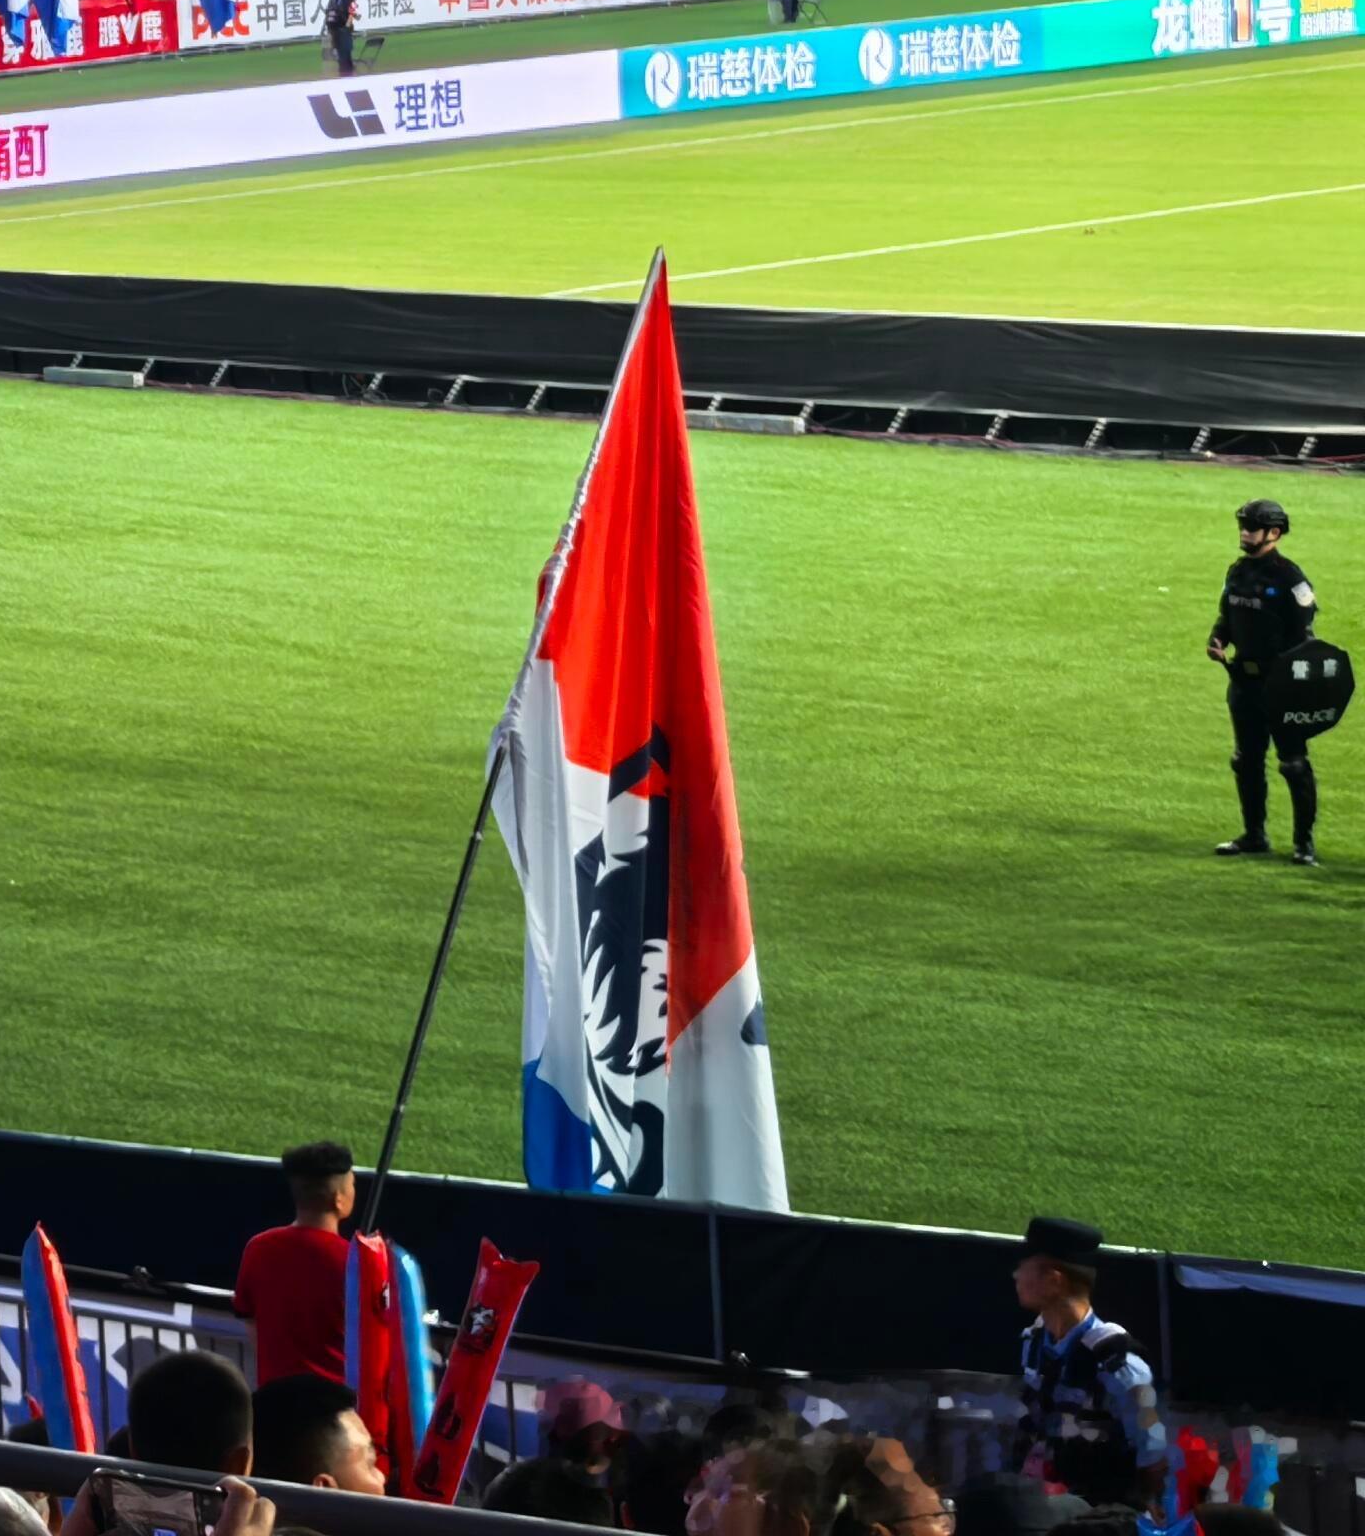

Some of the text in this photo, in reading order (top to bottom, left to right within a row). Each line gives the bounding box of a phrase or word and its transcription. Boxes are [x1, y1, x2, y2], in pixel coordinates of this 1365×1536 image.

[685, 40, 817, 102] 瑞慈体检
[899, 19, 1023, 78] 瑞慈体检
[393, 79, 465, 133] 理想
